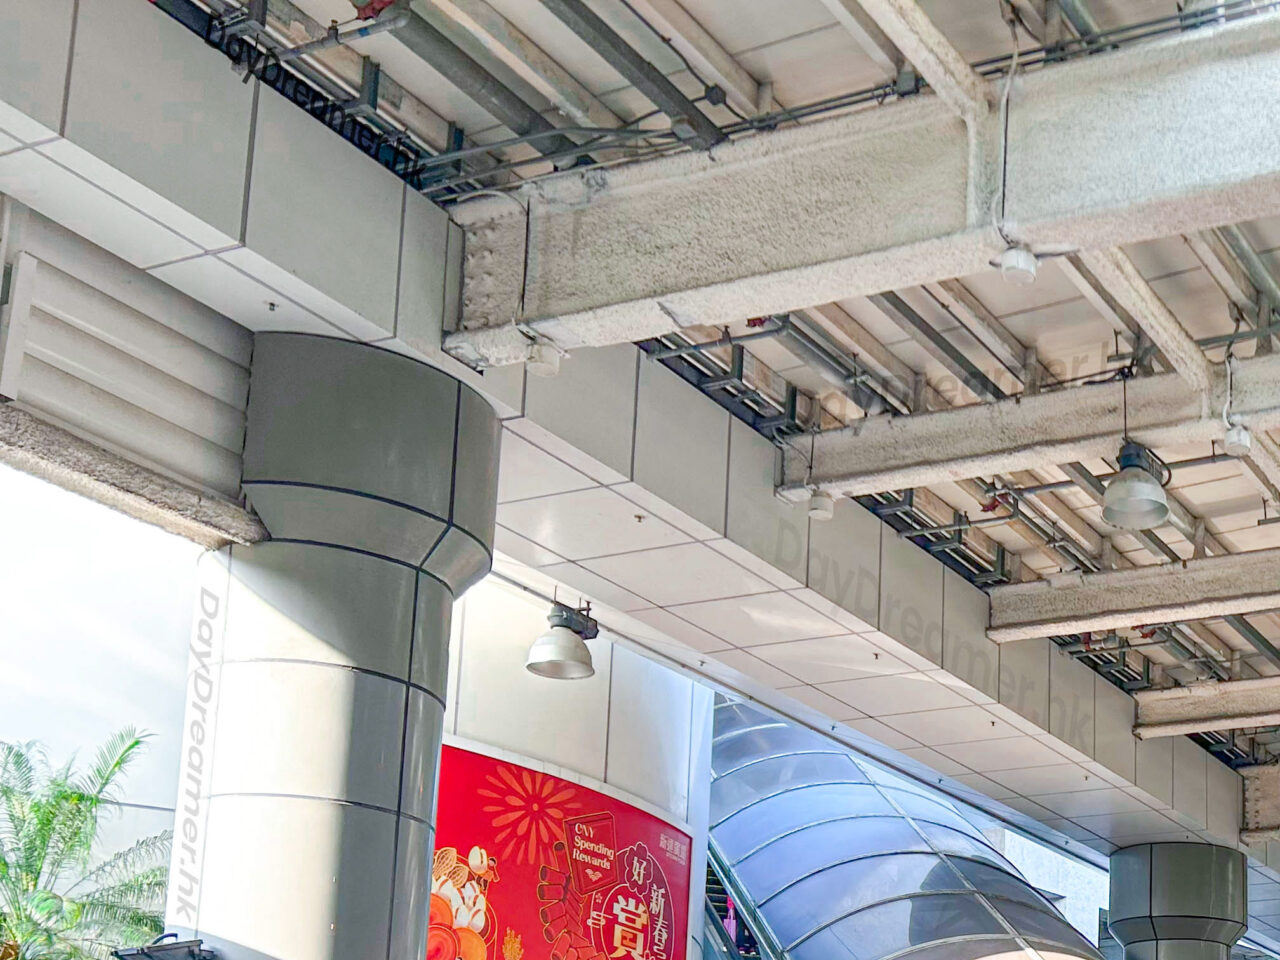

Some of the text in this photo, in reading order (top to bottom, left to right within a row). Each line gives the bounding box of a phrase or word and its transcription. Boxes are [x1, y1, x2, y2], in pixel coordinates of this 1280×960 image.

[575, 822, 595, 839] CNY
[572, 848, 611, 870] Rewards
[574, 835, 615, 861] Spending
